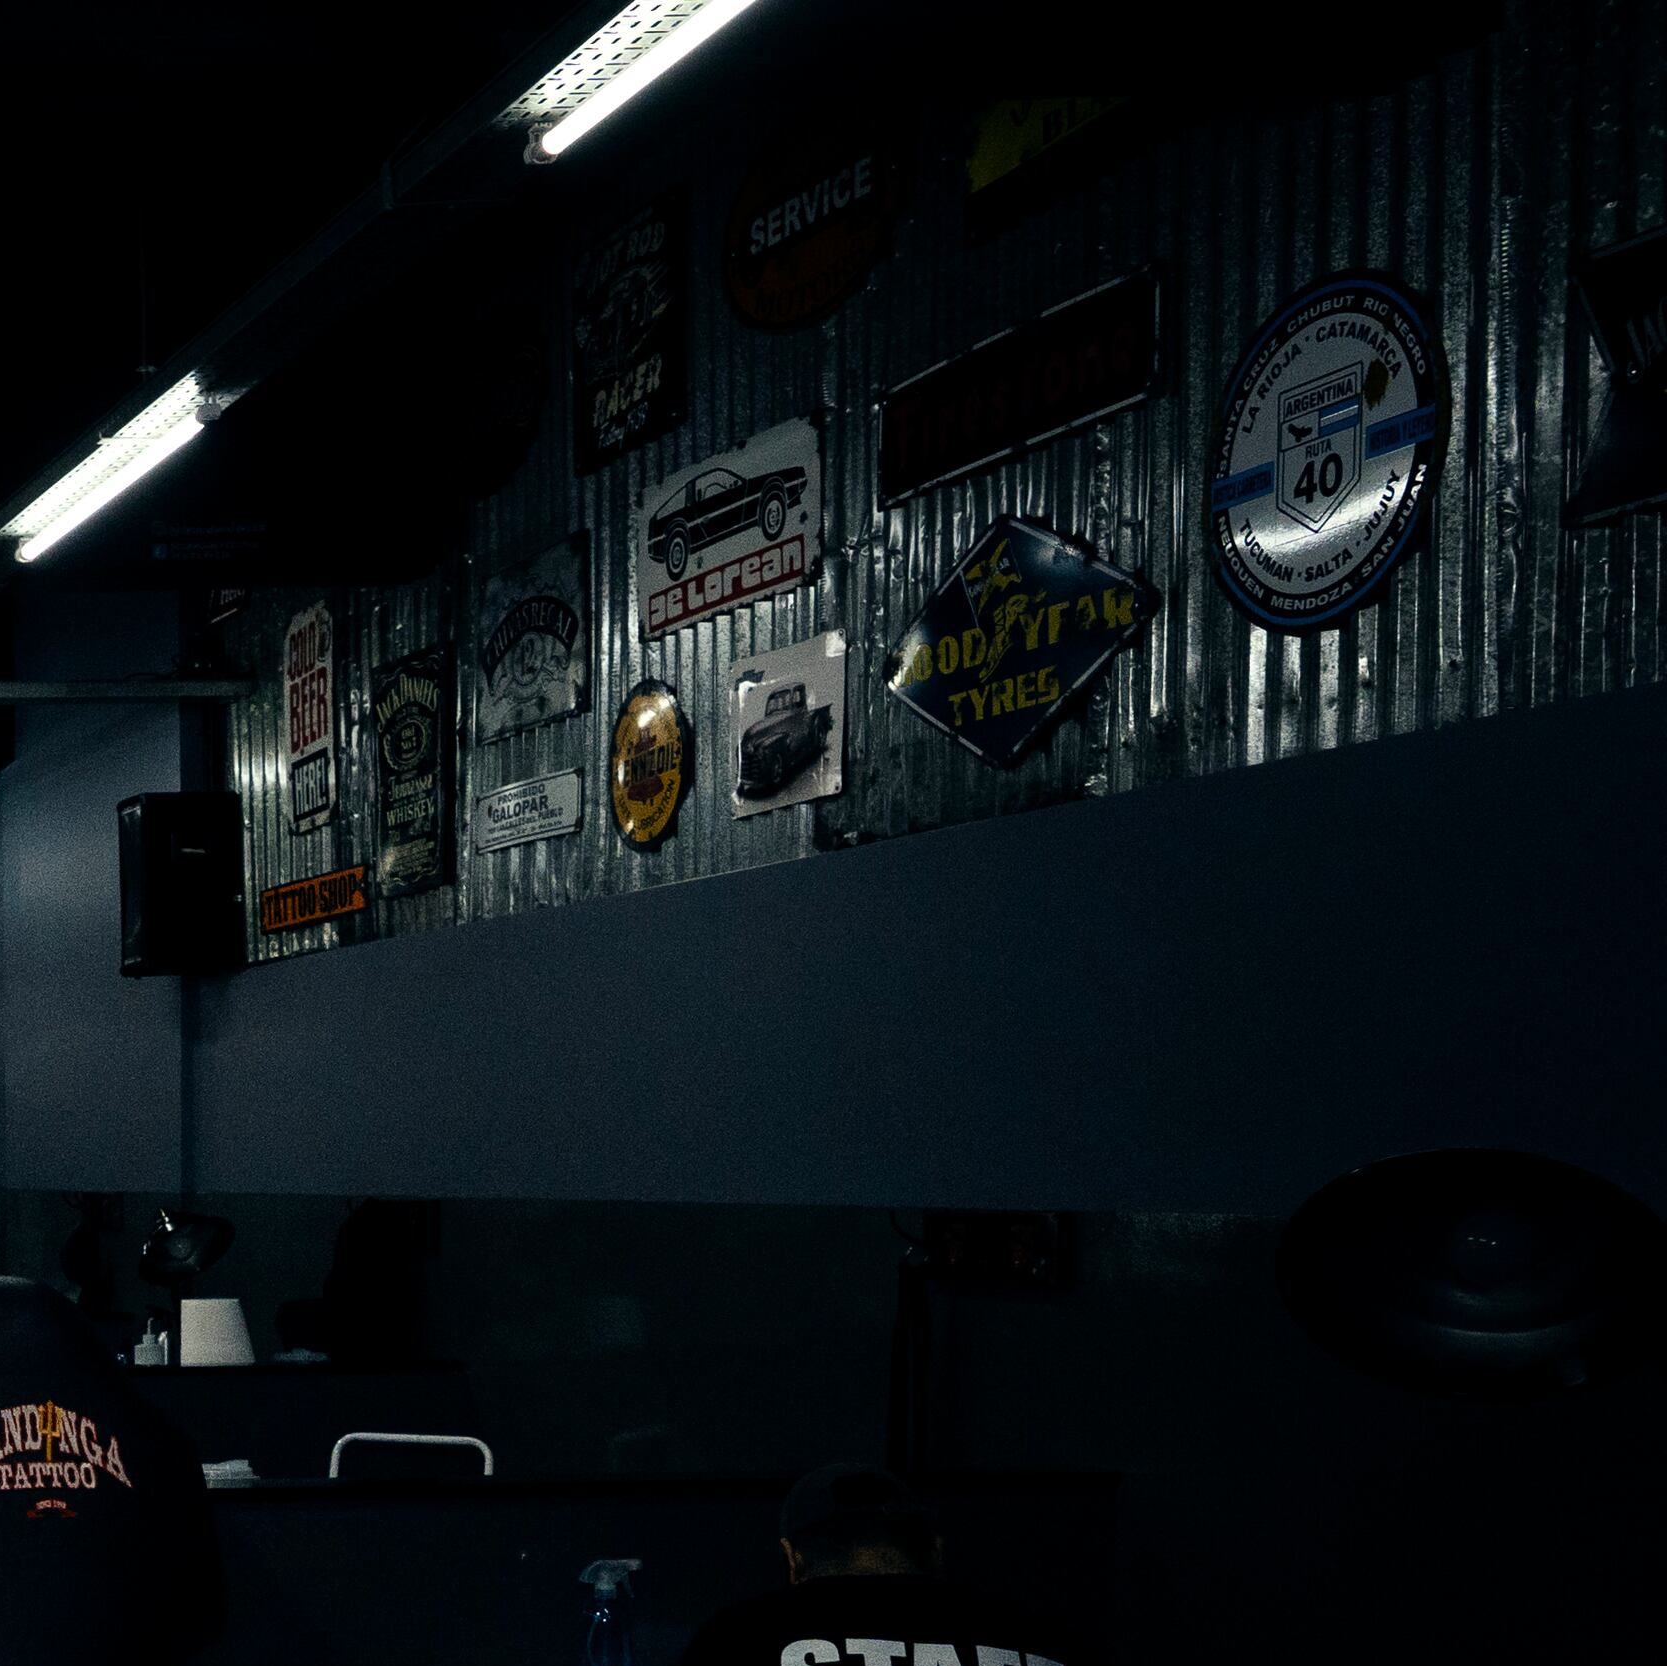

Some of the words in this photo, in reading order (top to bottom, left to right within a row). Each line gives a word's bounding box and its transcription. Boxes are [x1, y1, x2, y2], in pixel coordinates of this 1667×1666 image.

[749, 154, 873, 256] SERVICE
[1286, 295, 1355, 333] CHUBUT
[1394, 313, 1427, 376] NEGRO
[1317, 321, 1402, 380] CATAMARCA
[1242, 405, 1260, 433] LA
[1258, 346, 1302, 398] RIOJA
[1284, 377, 1354, 418] ARGENTINA
[1293, 453, 1343, 504] 40
[1305, 439, 1332, 459] RUTA
[1361, 535, 1395, 579] SAN
[1393, 463, 1427, 545] JUAN
[1363, 469, 1401, 543] JUJUY
[1217, 515, 1265, 599] NEUQUEN
[1240, 518, 1294, 582] TUCUMAN
[1304, 549, 1353, 582] SALTA
[531, 601, 572, 643] REGAL
[1270, 581, 1353, 611] MENDOZA
[288, 620, 317, 681] COLD
[289, 666, 328, 755] BEER
[376, 689, 399, 733] JACK
[948, 664, 1060, 727] TYRES
[492, 795, 549, 823] GALOPAR
[497, 783, 546, 806] PROHIBIDO
[267, 880, 316, 927] TATTOO
[318, 872, 356, 913] SHOP
